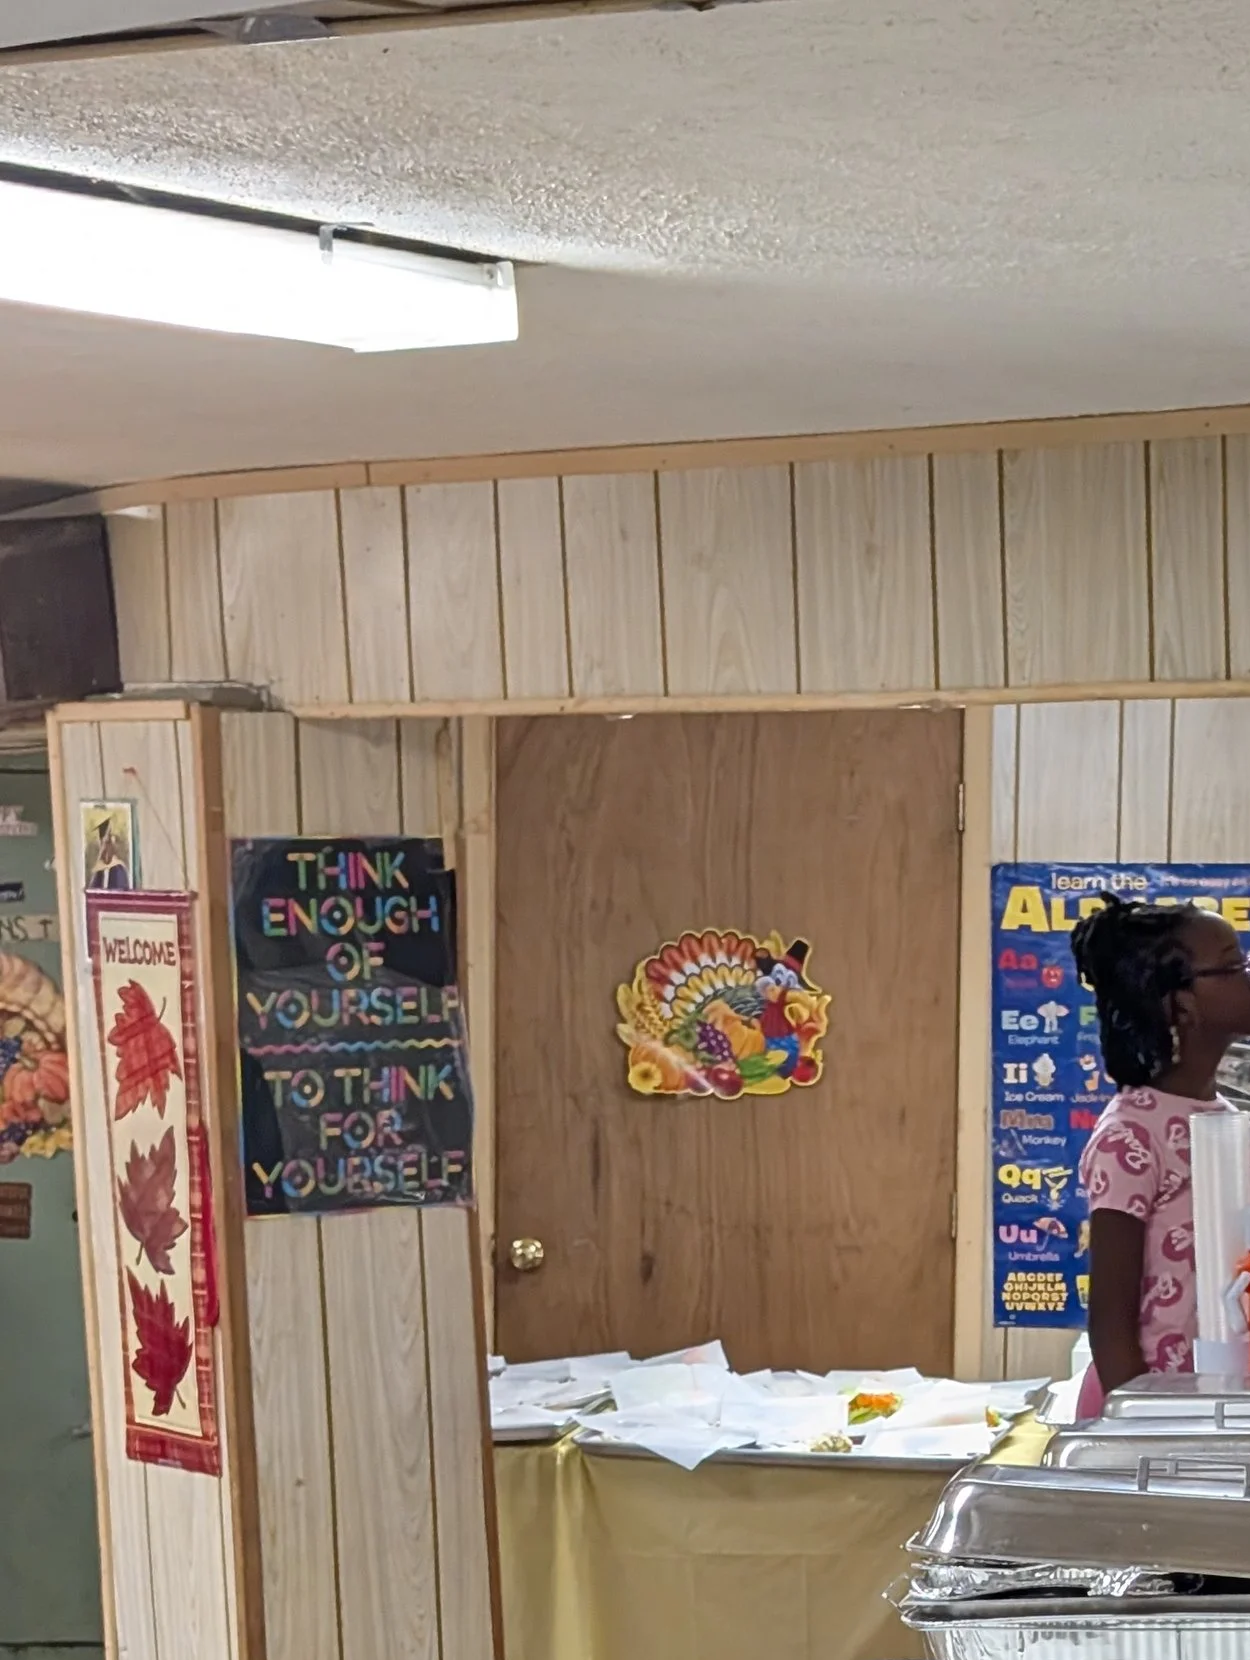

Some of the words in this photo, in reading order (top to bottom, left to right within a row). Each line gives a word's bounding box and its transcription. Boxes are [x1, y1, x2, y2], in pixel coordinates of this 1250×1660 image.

[286, 850, 410, 891] THINK
[1052, 873, 1105, 890] learn
[1112, 873, 1148, 890] the
[261, 895, 440, 937] ENOUGH
[102, 936, 176, 966] WELCOME
[326, 941, 385, 982] OF
[999, 948, 1038, 970] Aa
[246, 985, 459, 1030] YOURSELF
[1079, 1005, 1098, 1026] F
[1000, 1010, 1039, 1030] Ee
[1008, 1034, 1060, 1046] Elephant
[263, 1068, 325, 1109] TO
[333, 1064, 454, 1105] THINK
[1004, 1092, 1024, 1102] Ice
[1025, 1091, 1064, 1102] Cream
[319, 1109, 403, 1150] FOR
[1022, 1135, 1067, 1147] Monkey
[252, 1150, 465, 1199] YOURSELF
[998, 1164, 1042, 1189] Qq
[999, 1224, 1038, 1243] Uu
[1008, 1251, 1060, 1261] Umbrella
[1007, 1272, 1064, 1282] ABCDEF
